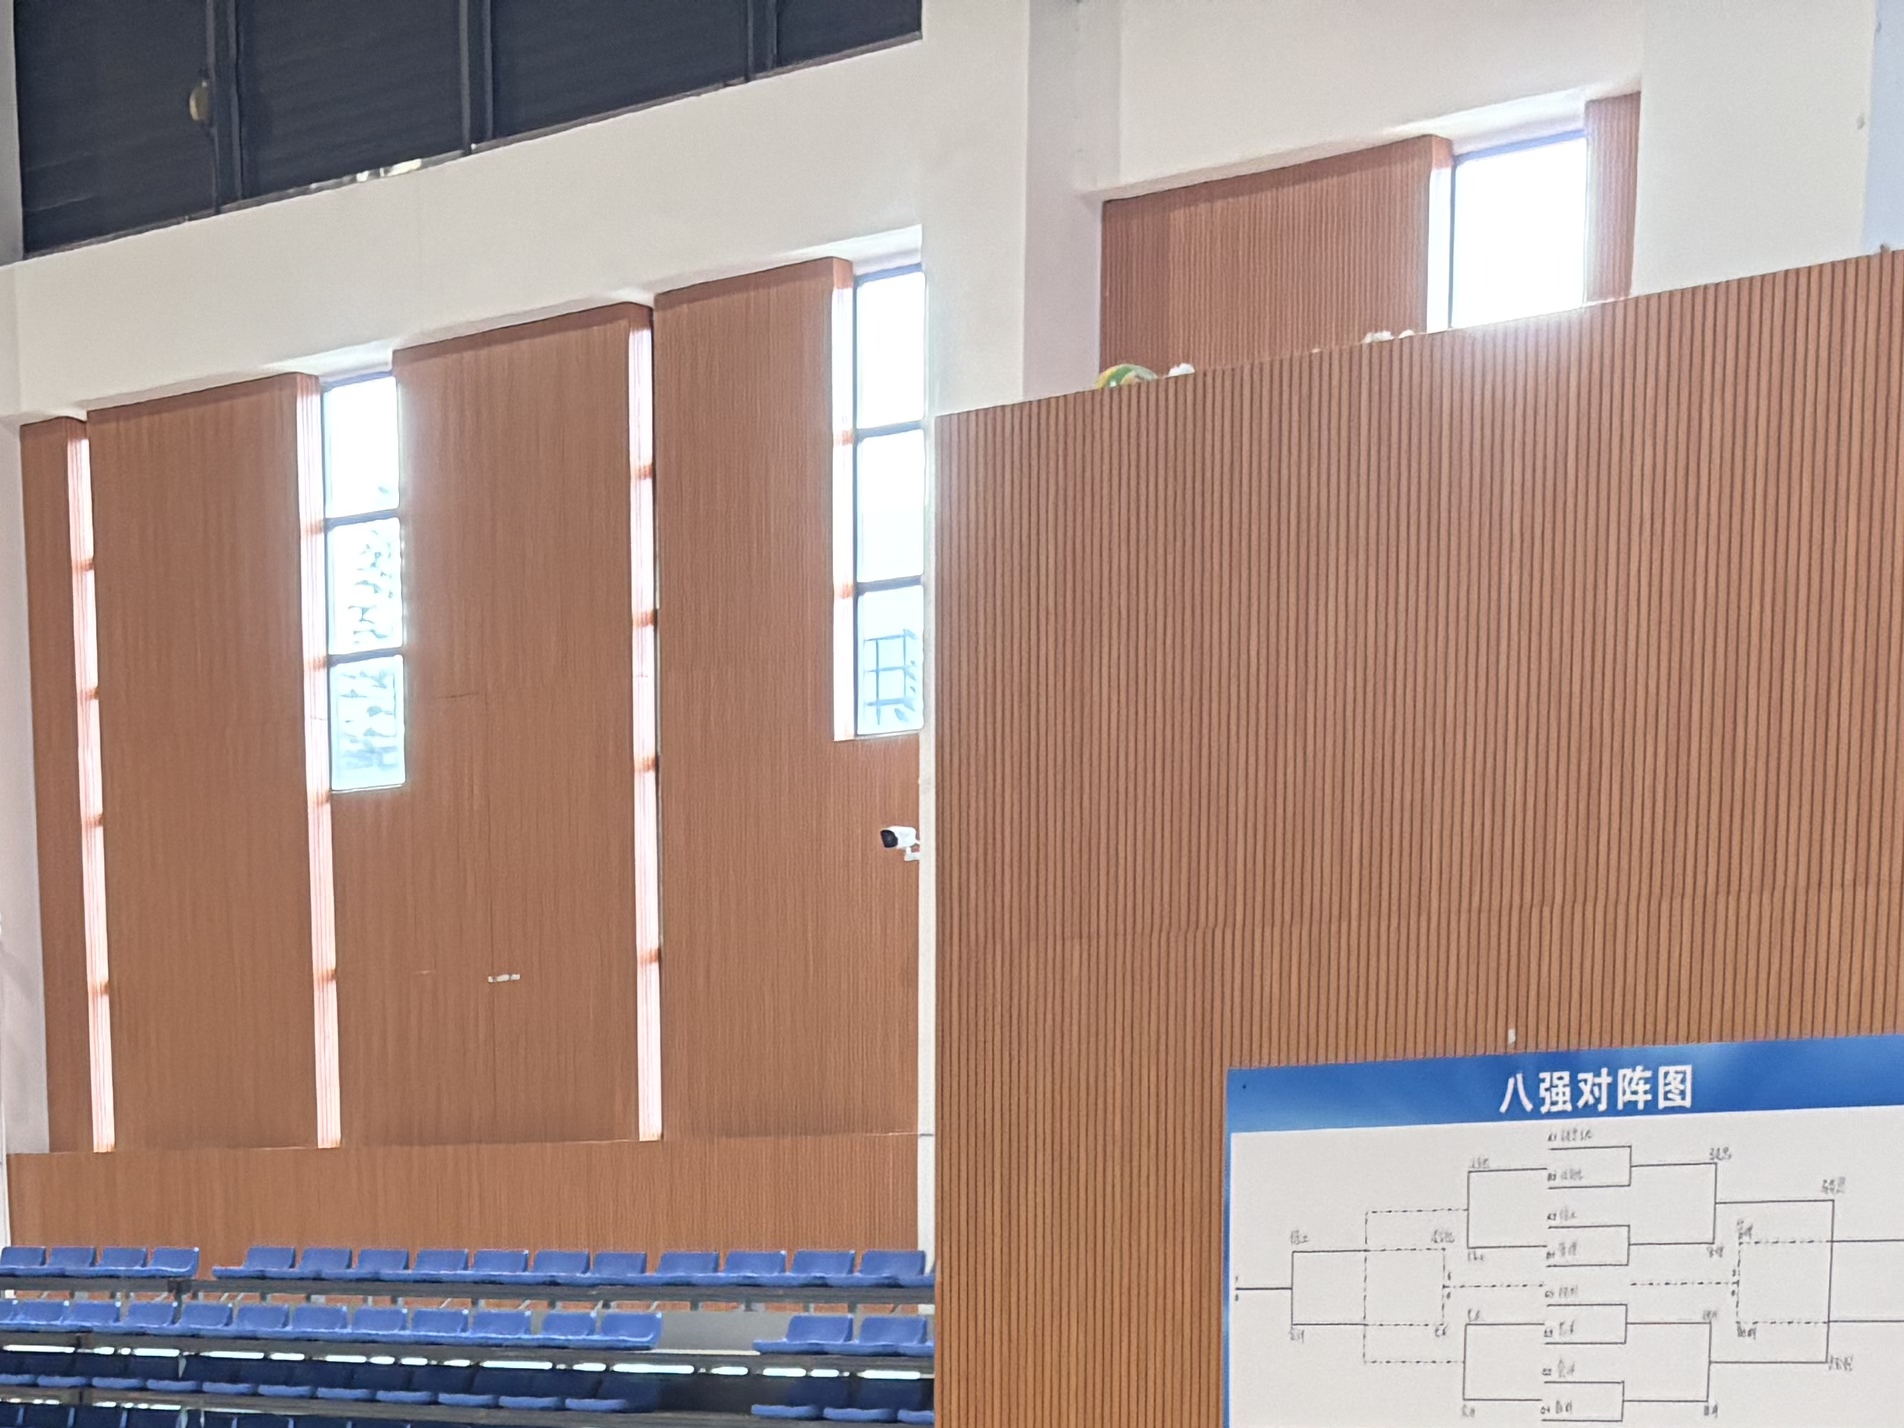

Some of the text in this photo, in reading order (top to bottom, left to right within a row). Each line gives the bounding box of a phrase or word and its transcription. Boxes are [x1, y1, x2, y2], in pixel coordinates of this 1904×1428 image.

[1499, 1064, 1693, 1114] 八强对阵图
